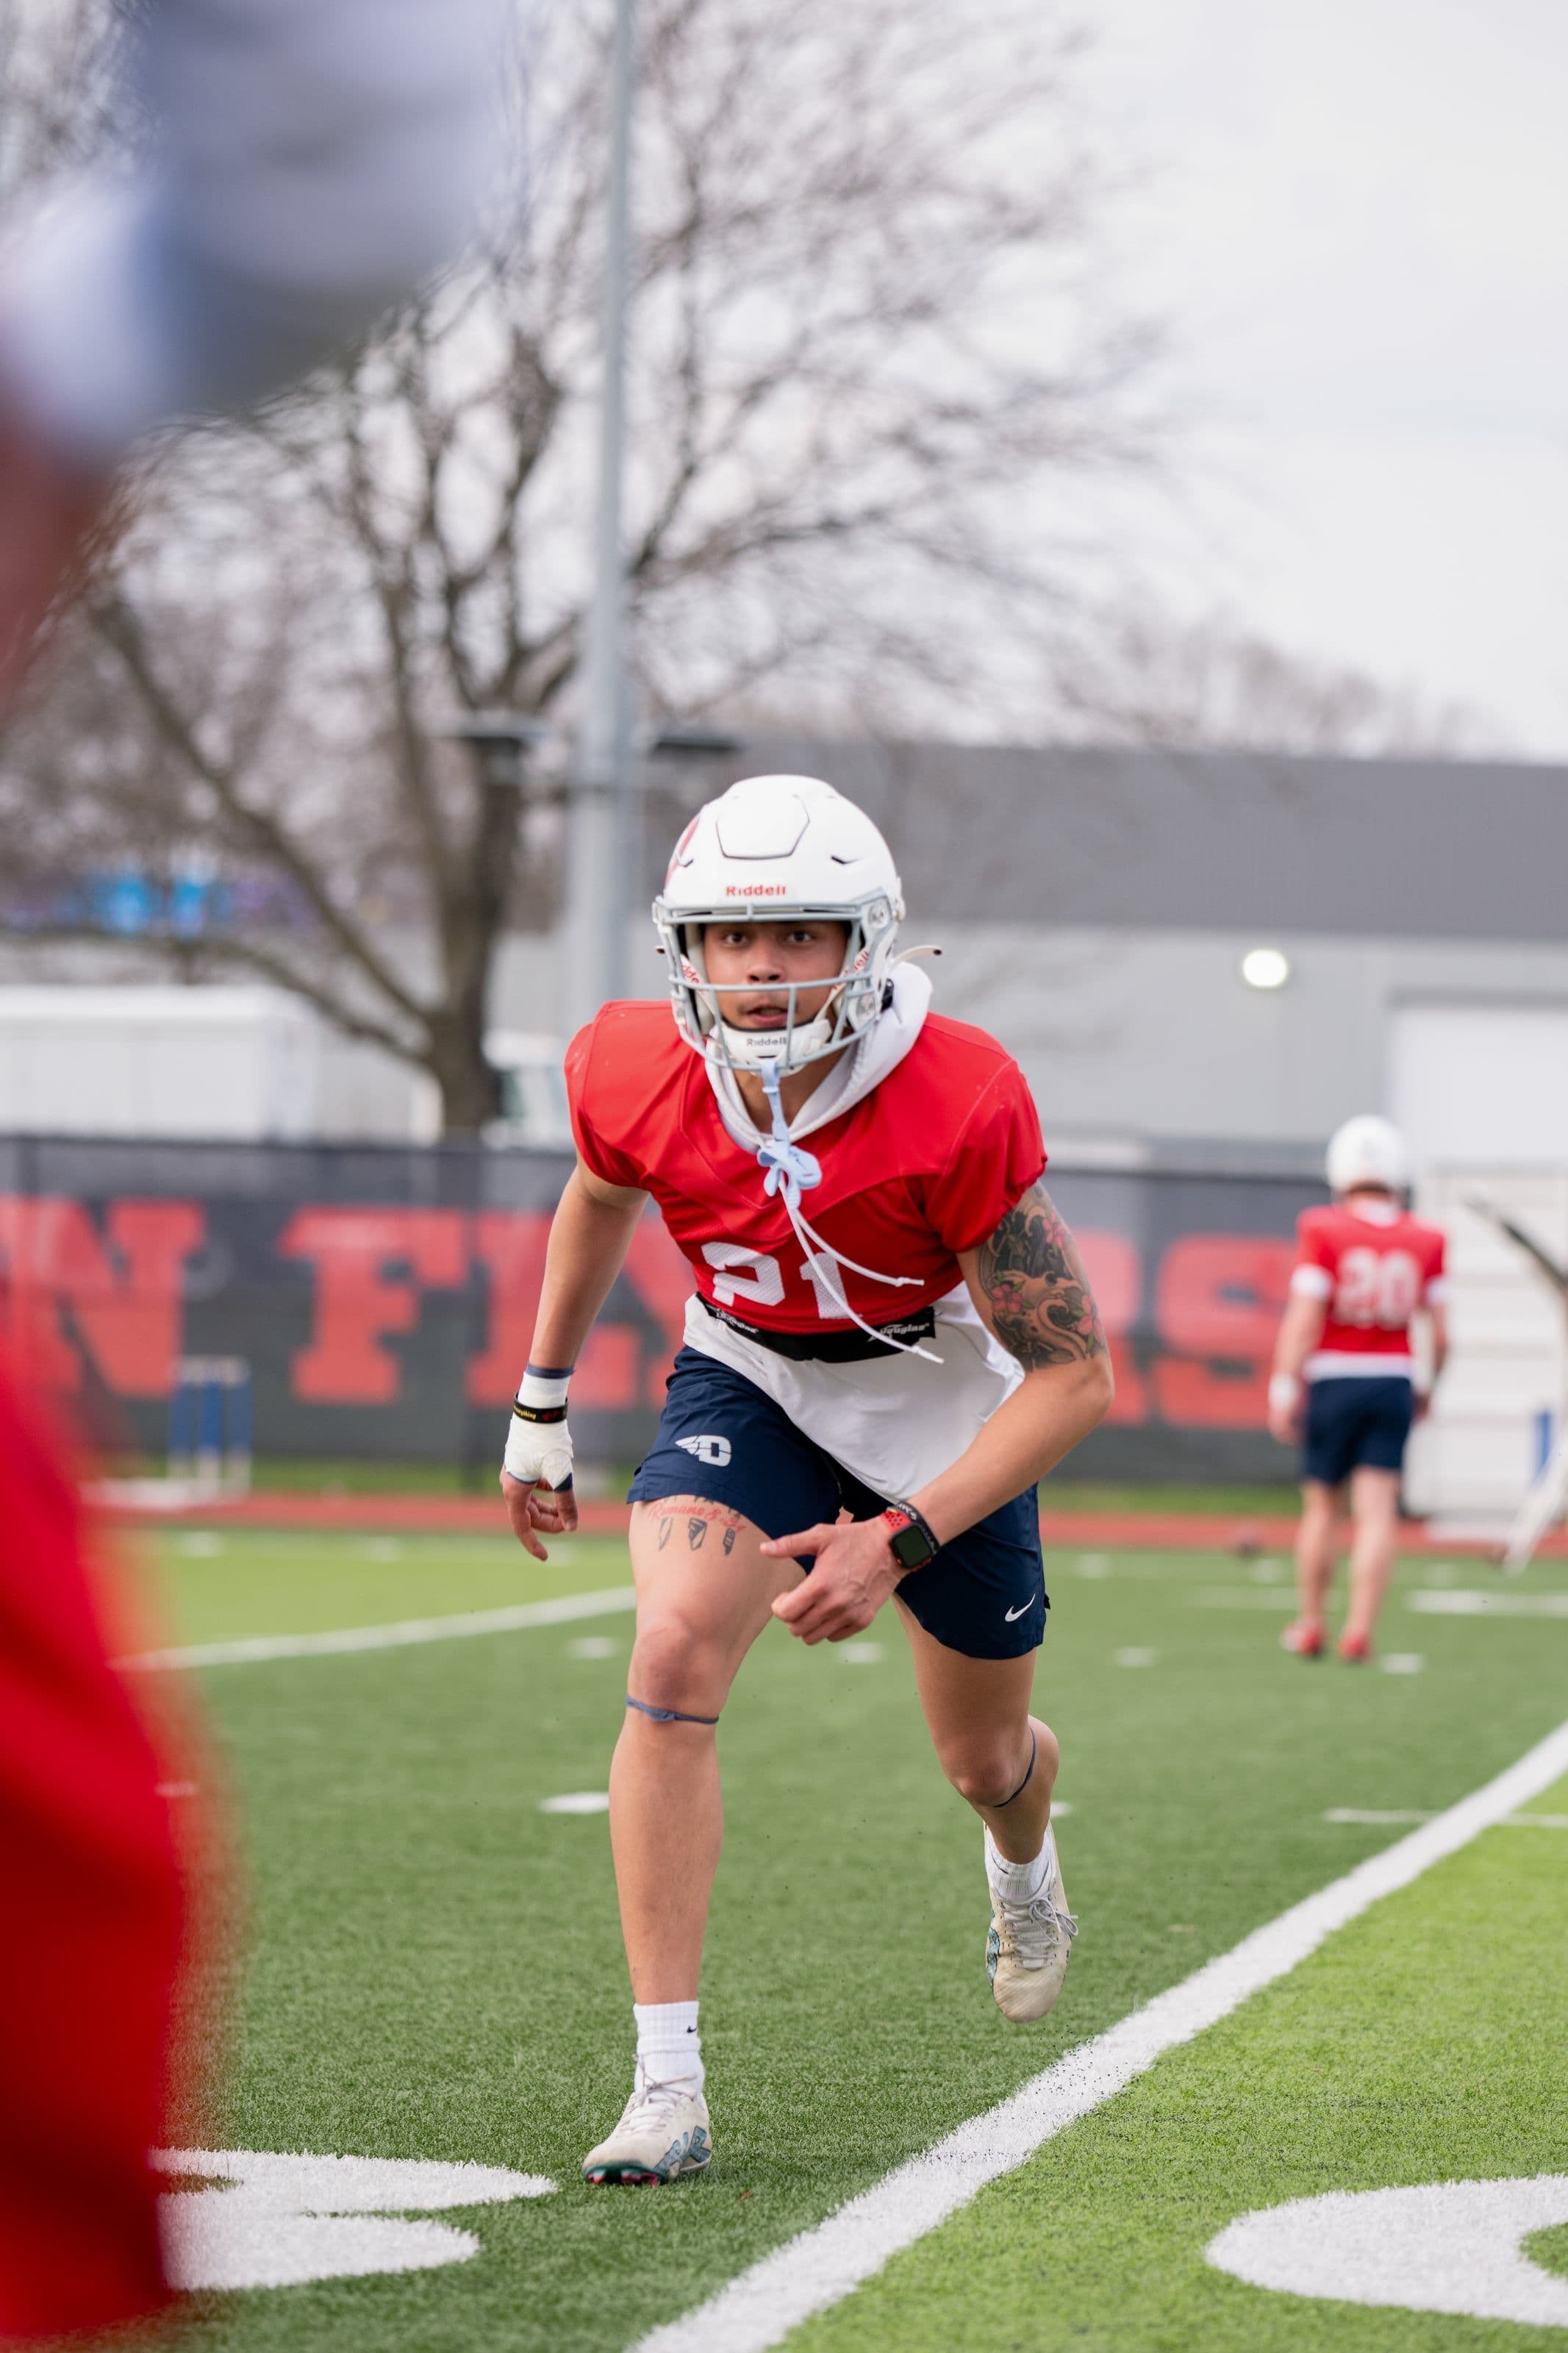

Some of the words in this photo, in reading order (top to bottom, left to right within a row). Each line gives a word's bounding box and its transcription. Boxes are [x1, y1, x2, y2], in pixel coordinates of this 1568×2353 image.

[726, 885, 786, 896] Riddell
[746, 1036, 787, 1046] Riddell
[701, 1241, 862, 1319] 21
[1336, 1248, 1420, 1330] 20
